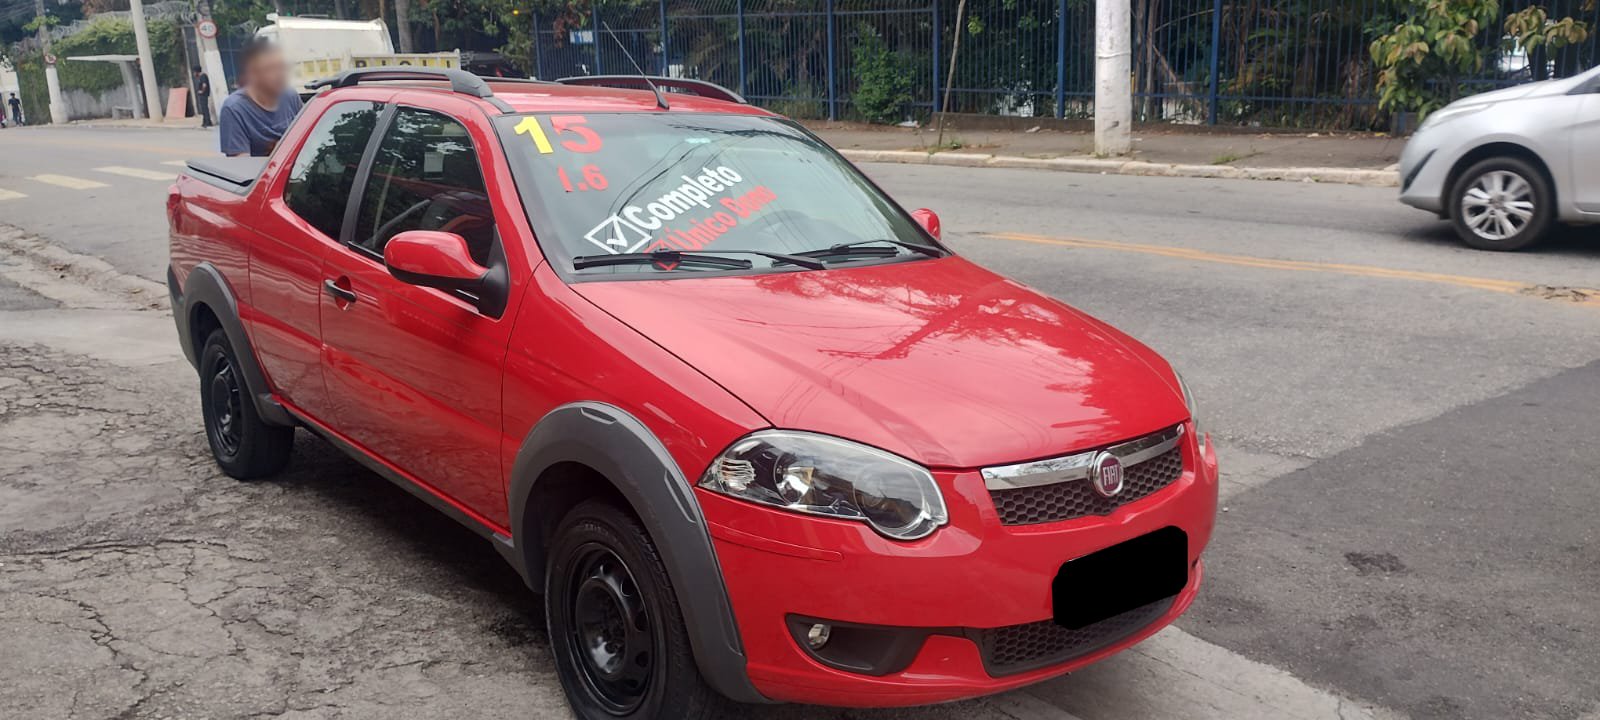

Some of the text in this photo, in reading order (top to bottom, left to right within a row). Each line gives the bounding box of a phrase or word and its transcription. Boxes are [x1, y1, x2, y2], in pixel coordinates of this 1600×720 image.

[201, 24, 214, 33] 40
[513, 116, 603, 154] 15
[557, 164, 609, 193] 1.6
[622, 166, 743, 230] Completo
[1102, 464, 1119, 486] FIAT
